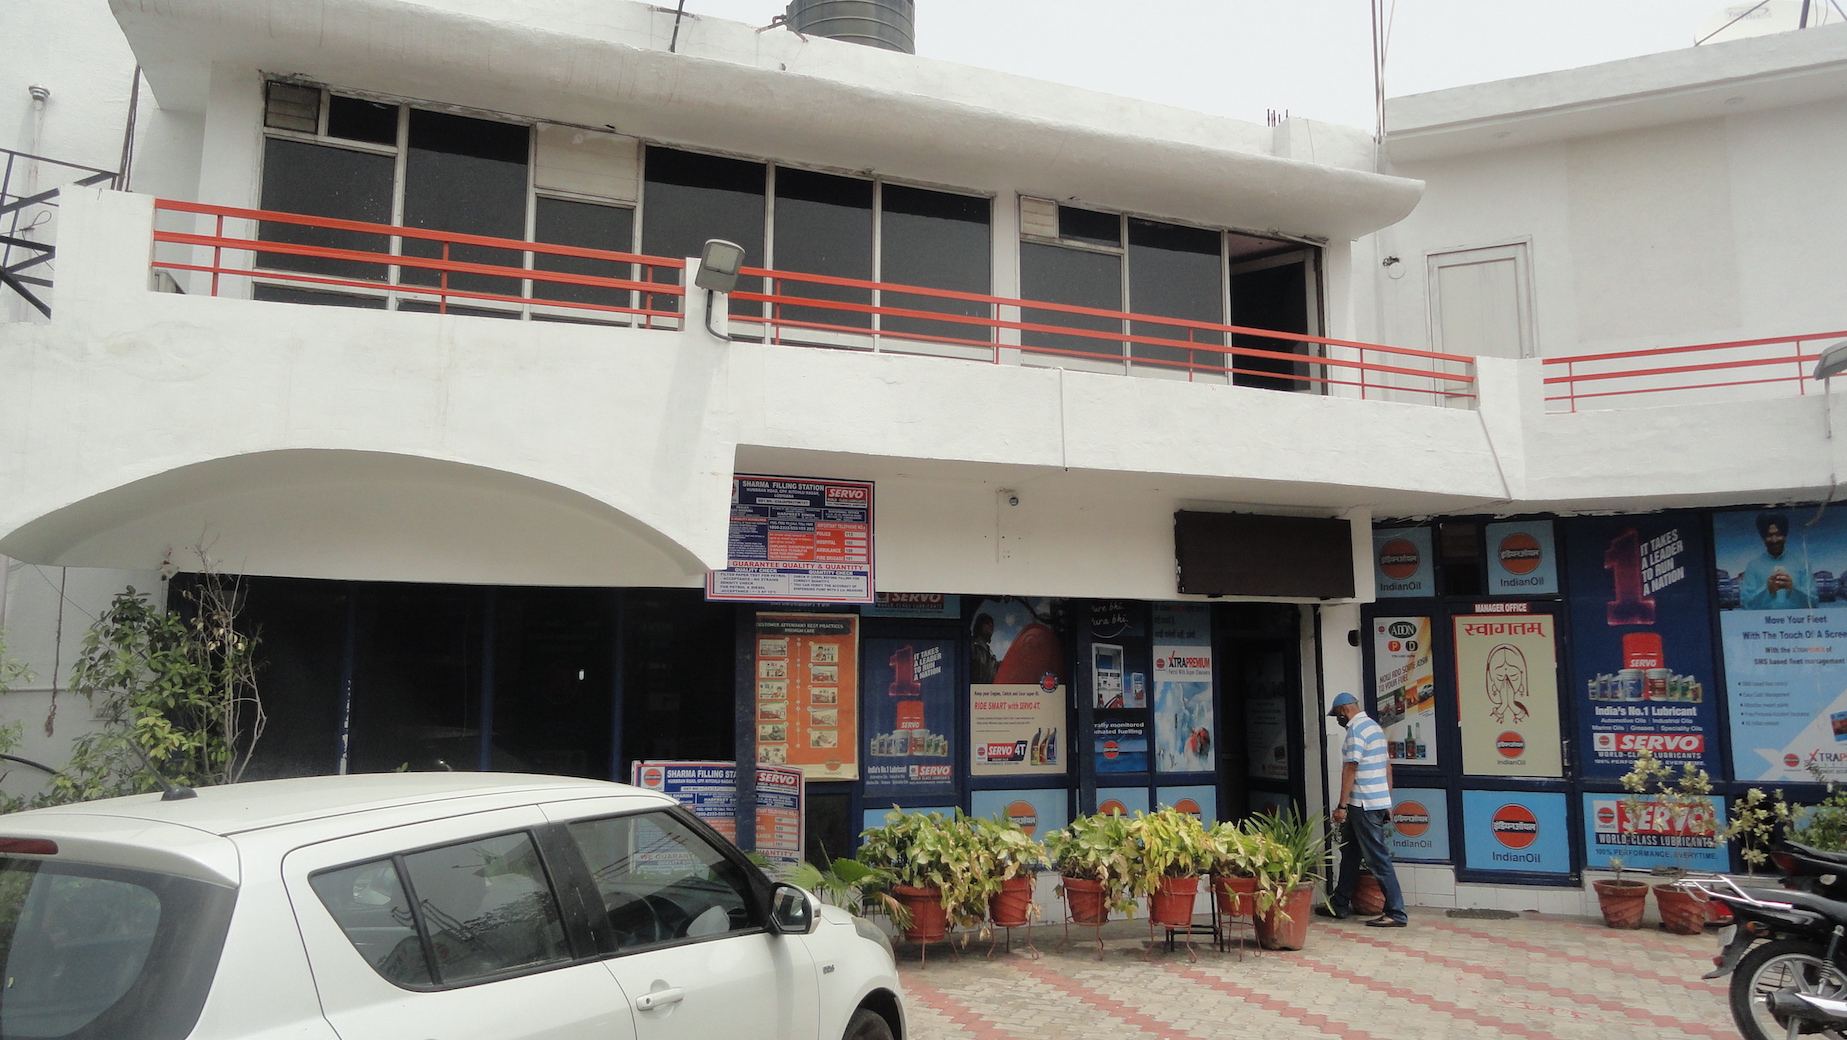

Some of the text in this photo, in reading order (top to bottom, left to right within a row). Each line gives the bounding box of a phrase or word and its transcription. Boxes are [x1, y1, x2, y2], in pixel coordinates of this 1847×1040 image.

[828, 489, 864, 498] SERVO
[1640, 529, 1678, 556] IT TAKES
[1642, 540, 1683, 570] A LEADER
[1642, 557, 1674, 582] TO RUN
[1380, 582, 1421, 591] IndianOil
[1500, 577, 1544, 587] IndianOil
[1643, 566, 1684, 596] A NATION
[892, 593, 941, 602] SERVO
[1475, 603, 1527, 612] MANAGER OFFICE
[1765, 616, 1784, 624] Move
[1807, 615, 1827, 623] Fleet
[1463, 622, 1546, 637] स्वागतम्
[1742, 631, 1760, 639] With
[1779, 631, 1802, 639] Touch
[1805, 630, 1813, 638] Of
[1817, 630, 1823, 638] A
[921, 647, 939, 658] TAKES
[920, 653, 941, 665] LEADER
[1168, 652, 1210, 668] XTRAPREMIUM
[923, 662, 935, 671] RUN
[920, 666, 941, 679] NATION
[1380, 672, 1391, 684] NOW
[1392, 668, 1400, 679] ADD
[1379, 675, 1408, 692] TO YOUR FUEL
[1595, 706, 1697, 716] India's No.1 Lubricant
[1620, 735, 1699, 750] SERVO
[988, 744, 1026, 755] SERVO 4T
[667, 770, 696, 778] SHARMA
[698, 770, 724, 778] FILLING
[920, 766, 950, 775] SERVO
[759, 773, 795, 785] SERVO
[1393, 840, 1432, 848] IndianOil
[1492, 852, 1541, 863] IndianOil
